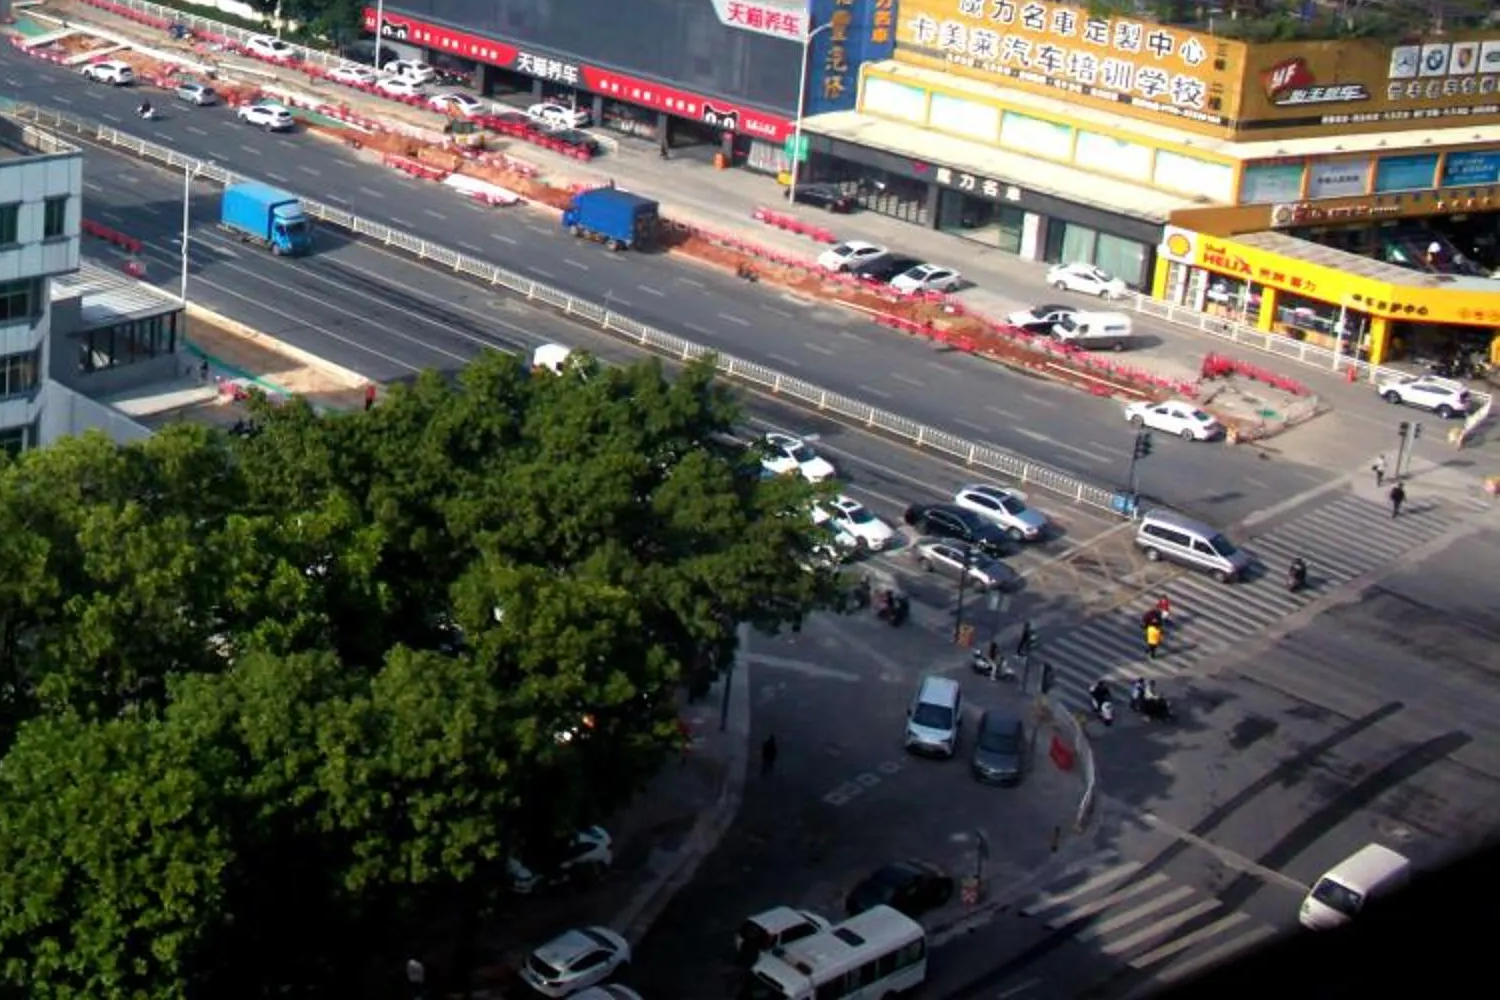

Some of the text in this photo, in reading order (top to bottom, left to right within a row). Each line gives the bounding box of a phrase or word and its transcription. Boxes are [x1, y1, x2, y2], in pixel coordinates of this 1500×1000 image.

[727, 1, 800, 36] 天猫养车
[517, 52, 580, 85] 天猫养车
[910, 16, 1208, 109] 卡美莱汽车培训学校
